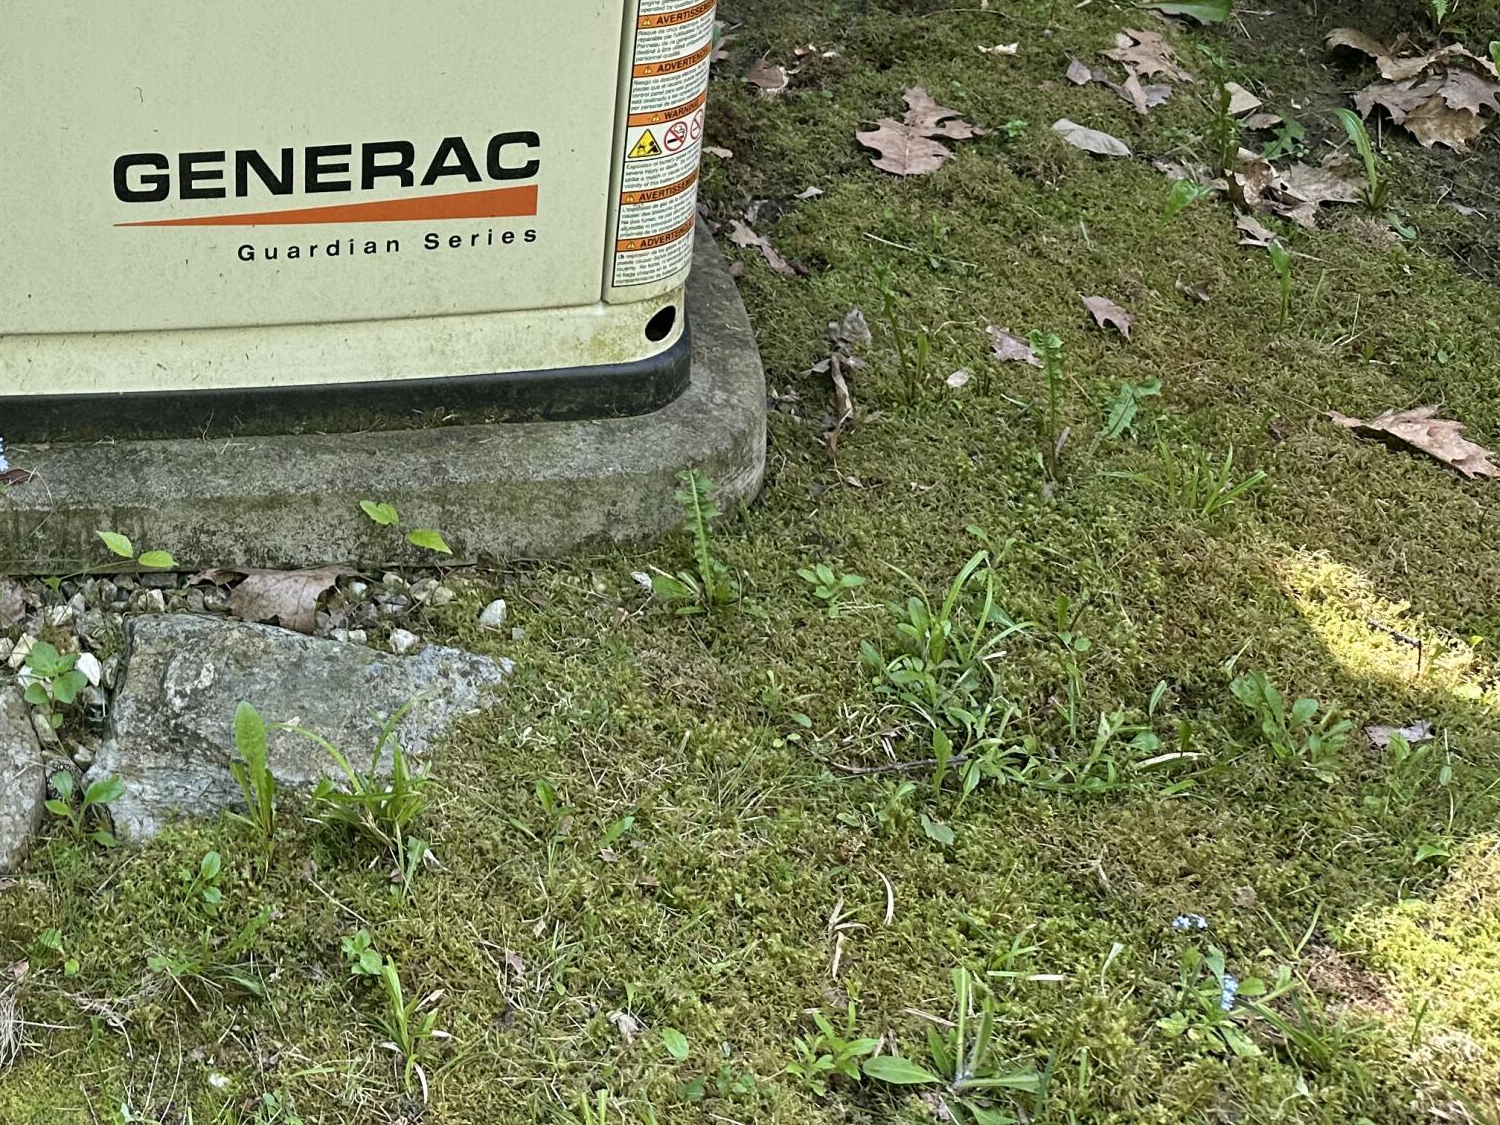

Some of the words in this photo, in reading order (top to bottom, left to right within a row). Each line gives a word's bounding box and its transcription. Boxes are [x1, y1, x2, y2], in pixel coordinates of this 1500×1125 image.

[657, 48, 708, 73] ADVERTENC
[664, 99, 699, 120] WARNING
[113, 131, 540, 203] GENERAC
[639, 173, 697, 202] AVERTISSEM
[237, 238, 400, 262] Guardian
[423, 228, 538, 250] Series
[640, 220, 691, 248] ADVERTEN
